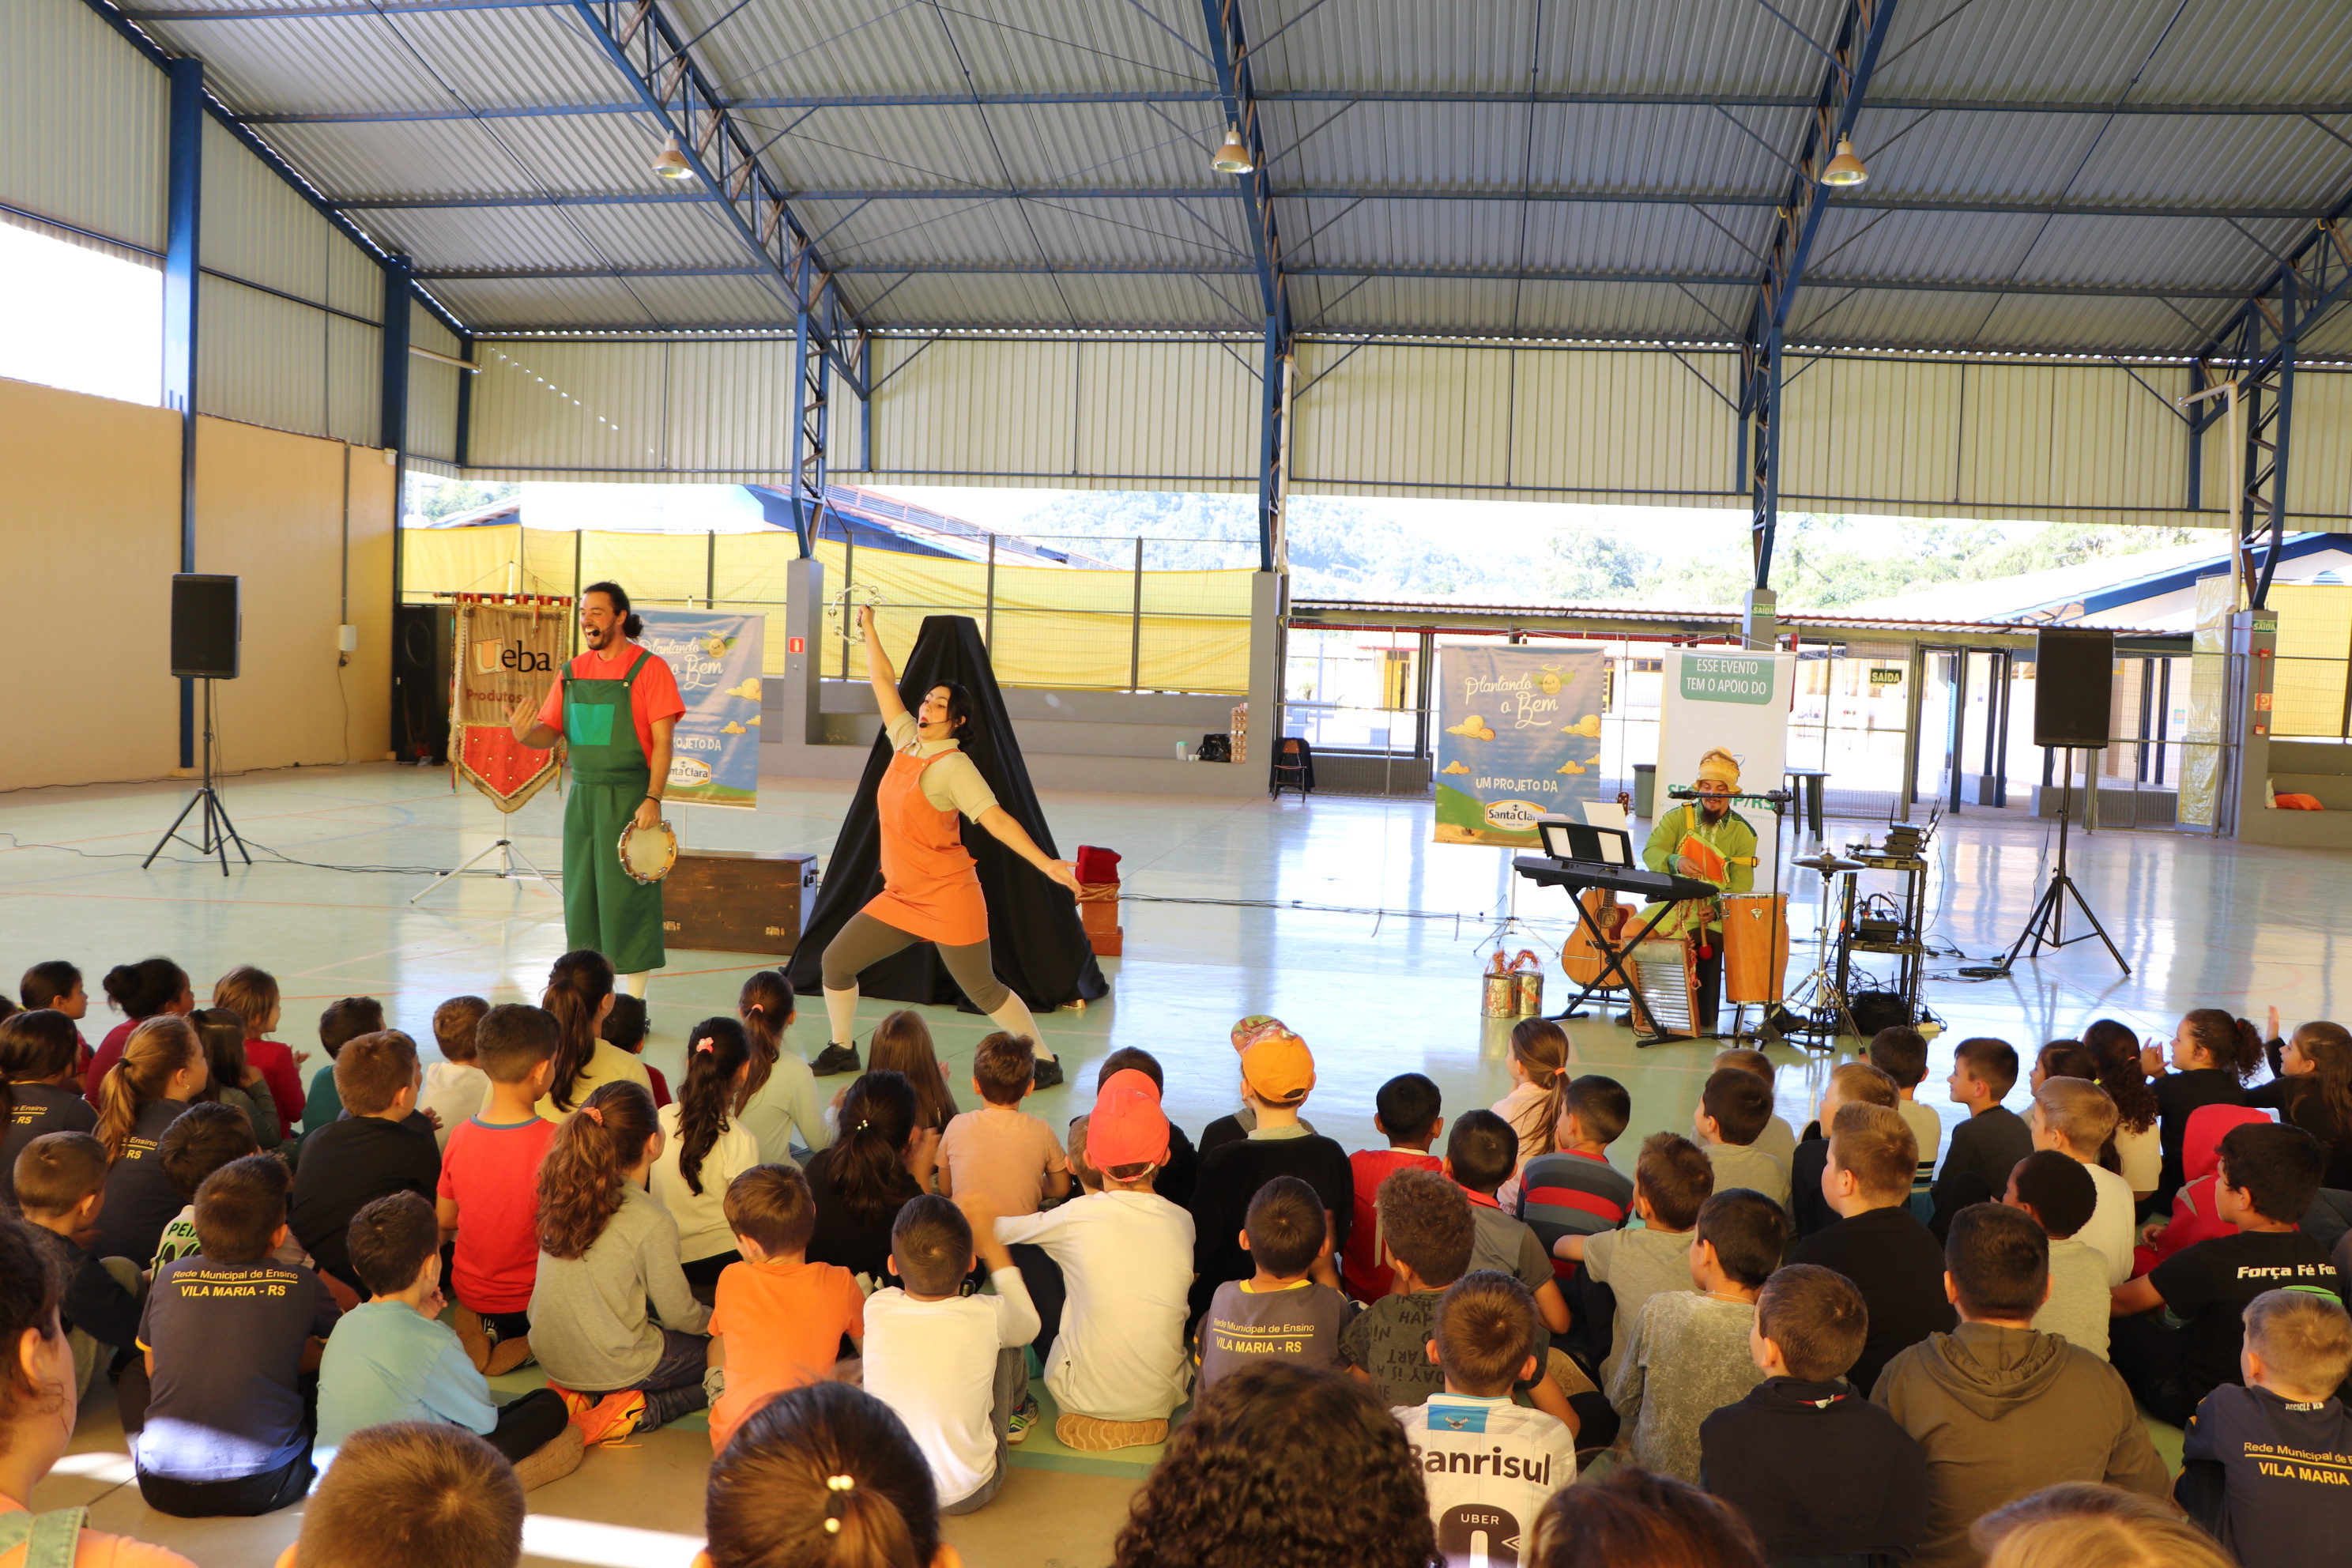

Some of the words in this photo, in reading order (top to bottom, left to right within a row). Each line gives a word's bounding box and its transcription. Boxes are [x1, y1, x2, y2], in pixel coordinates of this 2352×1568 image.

[683, 654, 724, 691] Bem
[1697, 658, 1718, 673] ESSE
[1721, 660, 1758, 675] EVENTO
[1871, 669, 1901, 683] SAÍDA
[1464, 672, 1532, 706] Plantando
[1687, 677, 1706, 691] TEM
[1707, 678, 1716, 692] O
[1717, 679, 1749, 694] APOIO
[1751, 681, 1767, 695] DO
[466, 688, 522, 703] Produtos
[1500, 701, 1511, 714] o
[1515, 691, 1559, 729] Bem
[707, 738, 722, 751] DA
[684, 767, 709, 778] Clara
[1476, 776, 1491, 790] UM
[1493, 778, 1540, 793] PROJETO
[1543, 780, 1559, 793] DA
[1488, 808, 1516, 820] Santa
[17, 1116, 32, 1125] RS
[130, 1136, 158, 1147] Ensino
[126, 1150, 142, 1159] RS
[200, 1270, 247, 1281] Municipal
[266, 1269, 298, 1280] Ensino
[2237, 1266, 2292, 1280] Força
[2297, 1264, 2316, 1276] Fé
[181, 1286, 209, 1296] VILA
[213, 1286, 256, 1296] MARIA
[267, 1285, 286, 1296] RS
[1213, 1317, 1227, 1328] Rede
[1227, 1321, 1265, 1334] Municipal
[1268, 1325, 1280, 1333] de
[1283, 1323, 1315, 1332] Ensino
[1216, 1336, 1233, 1351] VILA
[1235, 1340, 1275, 1353] MARIA
[1285, 1340, 1302, 1352] RS
[2244, 1442, 2274, 1453] Rede
[2277, 1445, 2332, 1462] Municipal
[2334, 1453, 2347, 1464] de
[1409, 1444, 1551, 1487] Banrisul
[2259, 1461, 2296, 1479] VILA
[2298, 1466, 2350, 1486] MARIA
[1461, 1513, 1500, 1525] UBER
